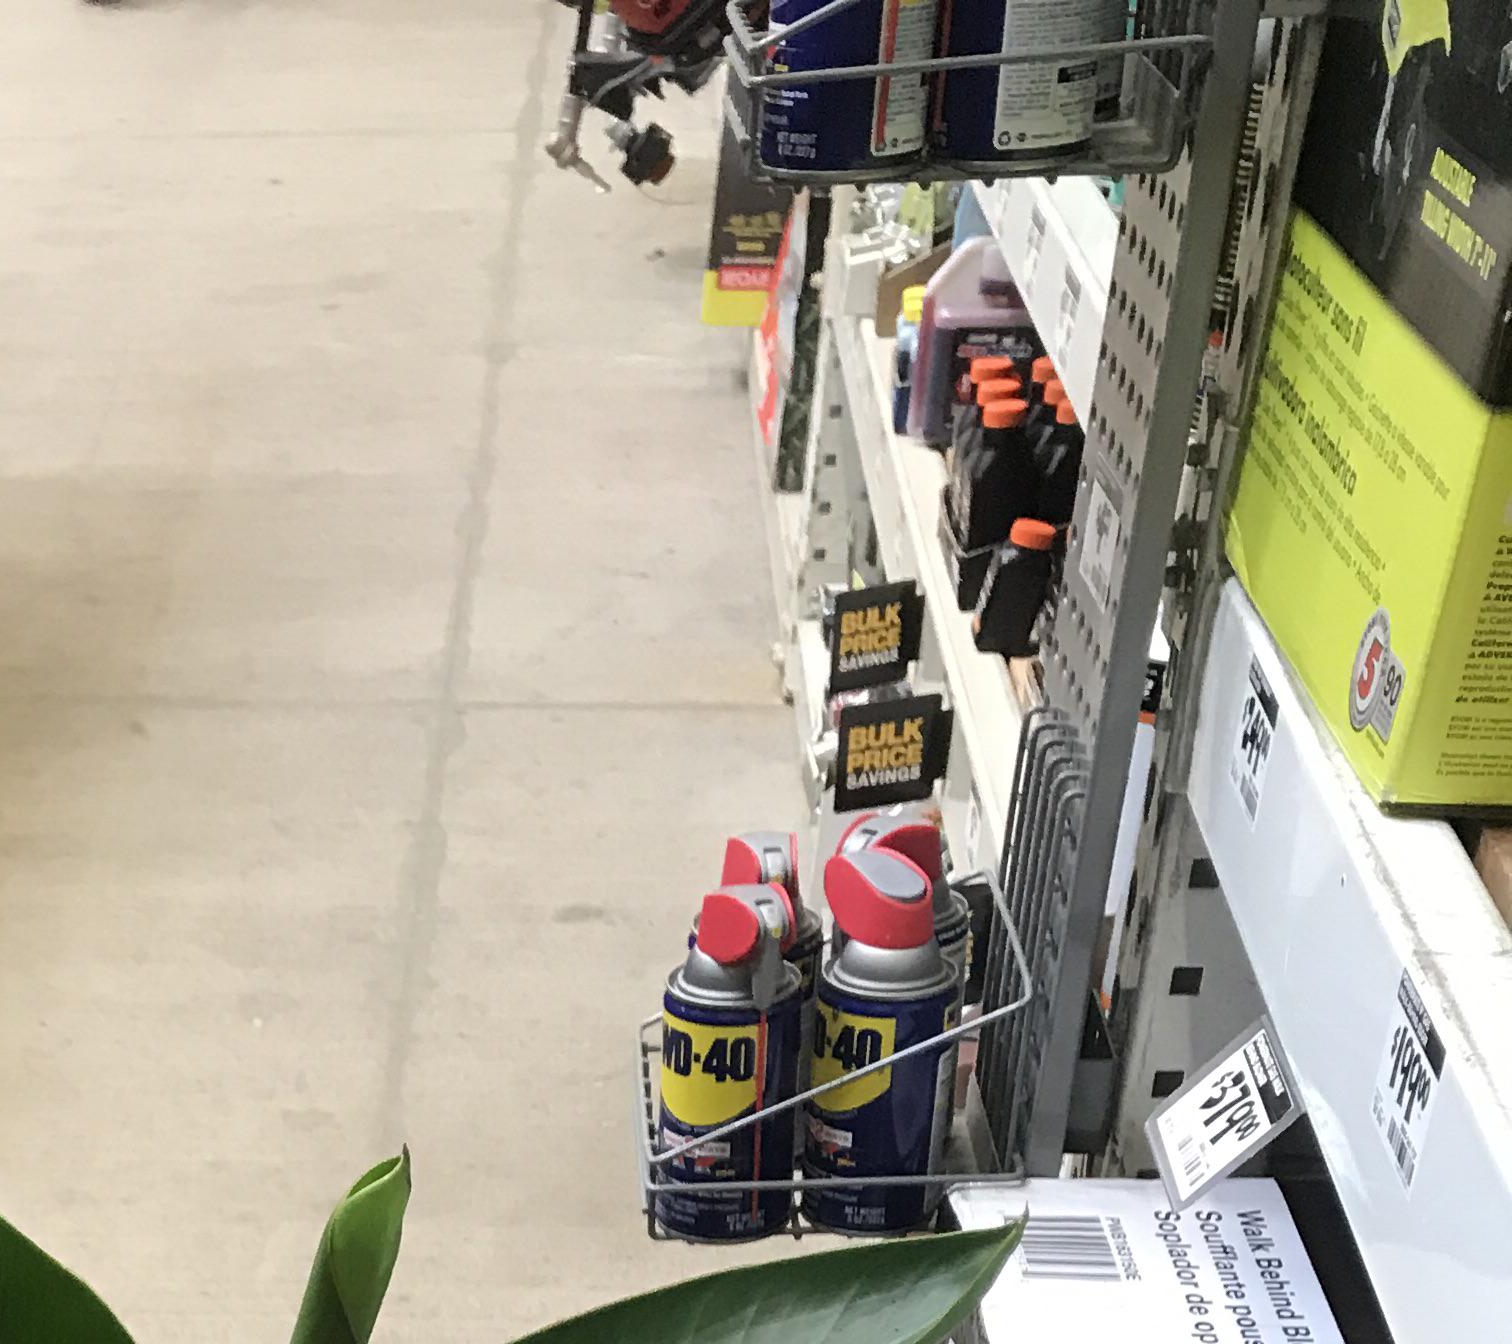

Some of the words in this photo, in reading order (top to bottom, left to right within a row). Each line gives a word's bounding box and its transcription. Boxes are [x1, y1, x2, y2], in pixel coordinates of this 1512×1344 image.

[841, 601, 902, 634] BULK
[840, 626, 901, 655] PRICE
[1357, 637, 1384, 700] 5
[849, 716, 924, 750] BULK
[847, 742, 922, 773] PRICE
[847, 765, 921, 790] SAVINGS
[1237, 1209, 1275, 1253] Walk
[1154, 1209, 1200, 1288] Soplador
[1185, 1292, 1213, 1316] de
[1195, 1209, 1246, 1300] Soufflante
[1255, 1257, 1305, 1320] Behind
